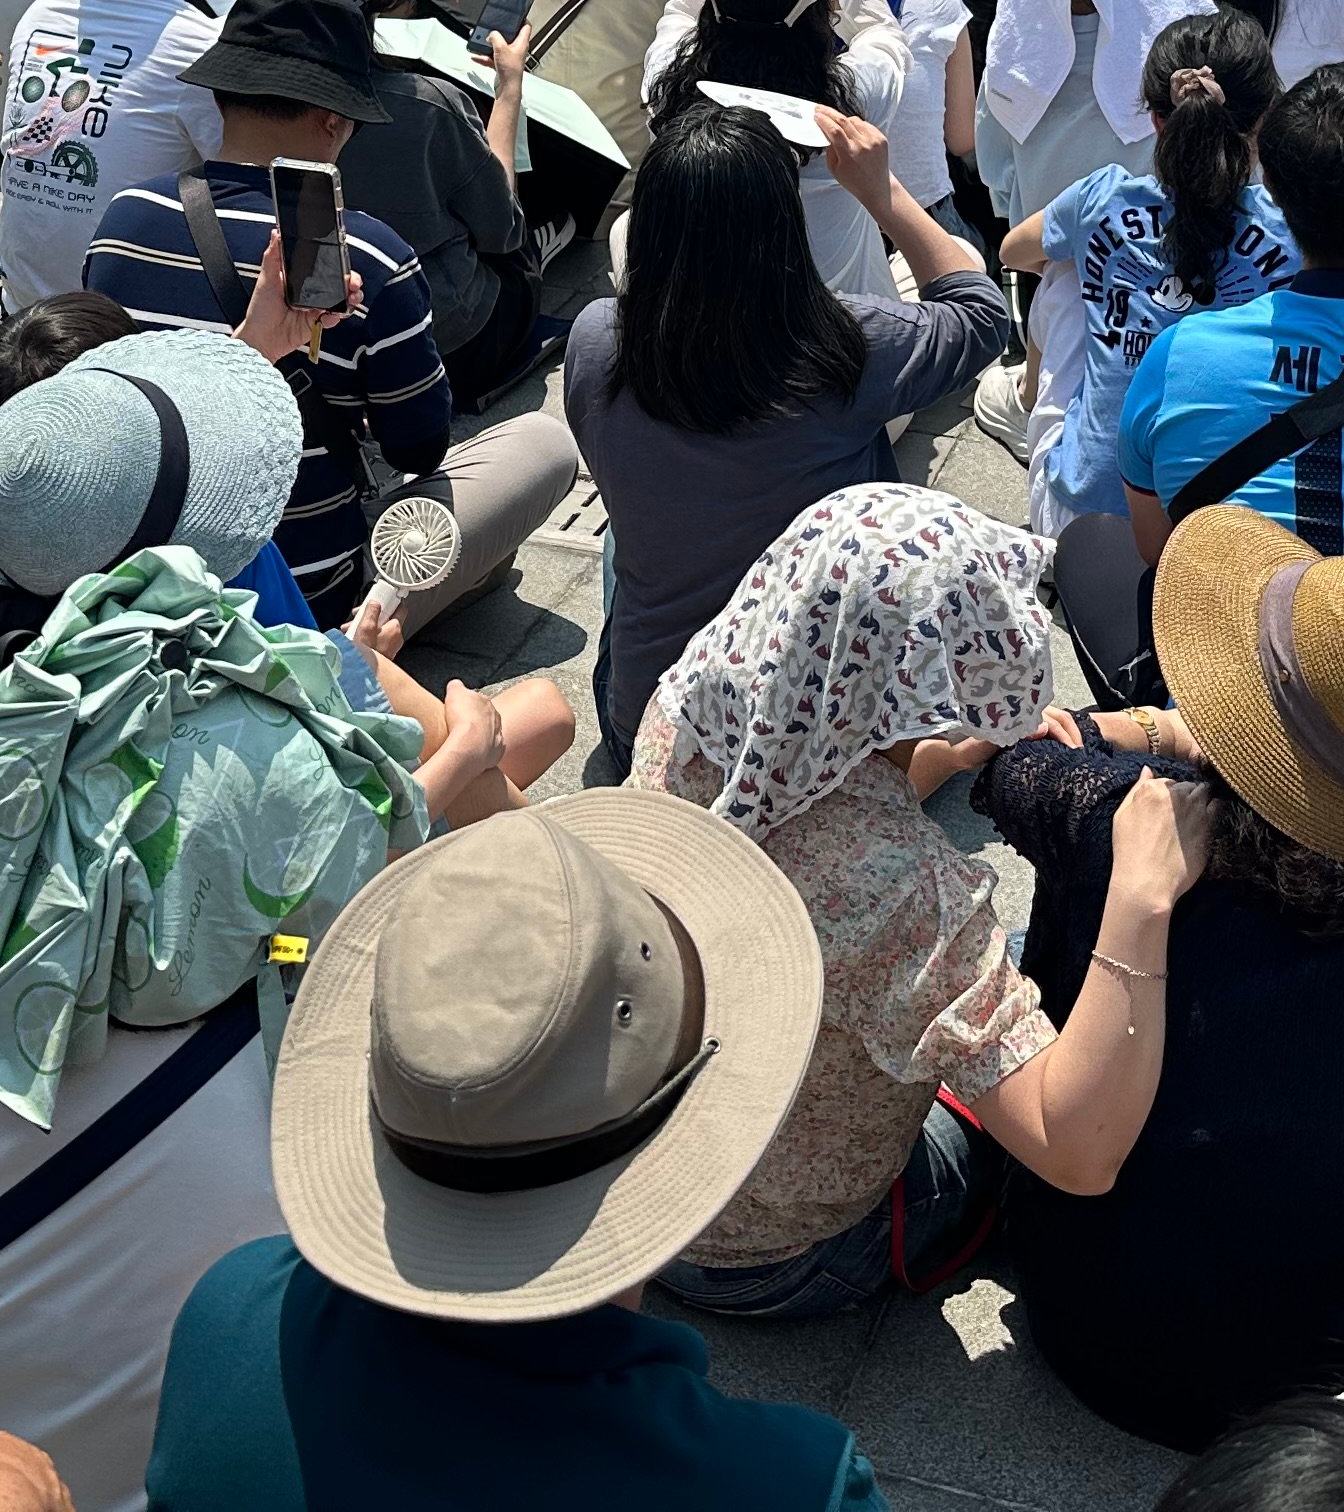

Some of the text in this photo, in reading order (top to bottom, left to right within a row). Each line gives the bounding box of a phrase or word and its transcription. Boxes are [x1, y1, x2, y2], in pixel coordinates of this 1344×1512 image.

[62, 205, 84, 214] WITH
[67, 191, 96, 204] DAY
[1081, 205, 1164, 304] HONEST
[170, 876, 212, 996] Lemon
